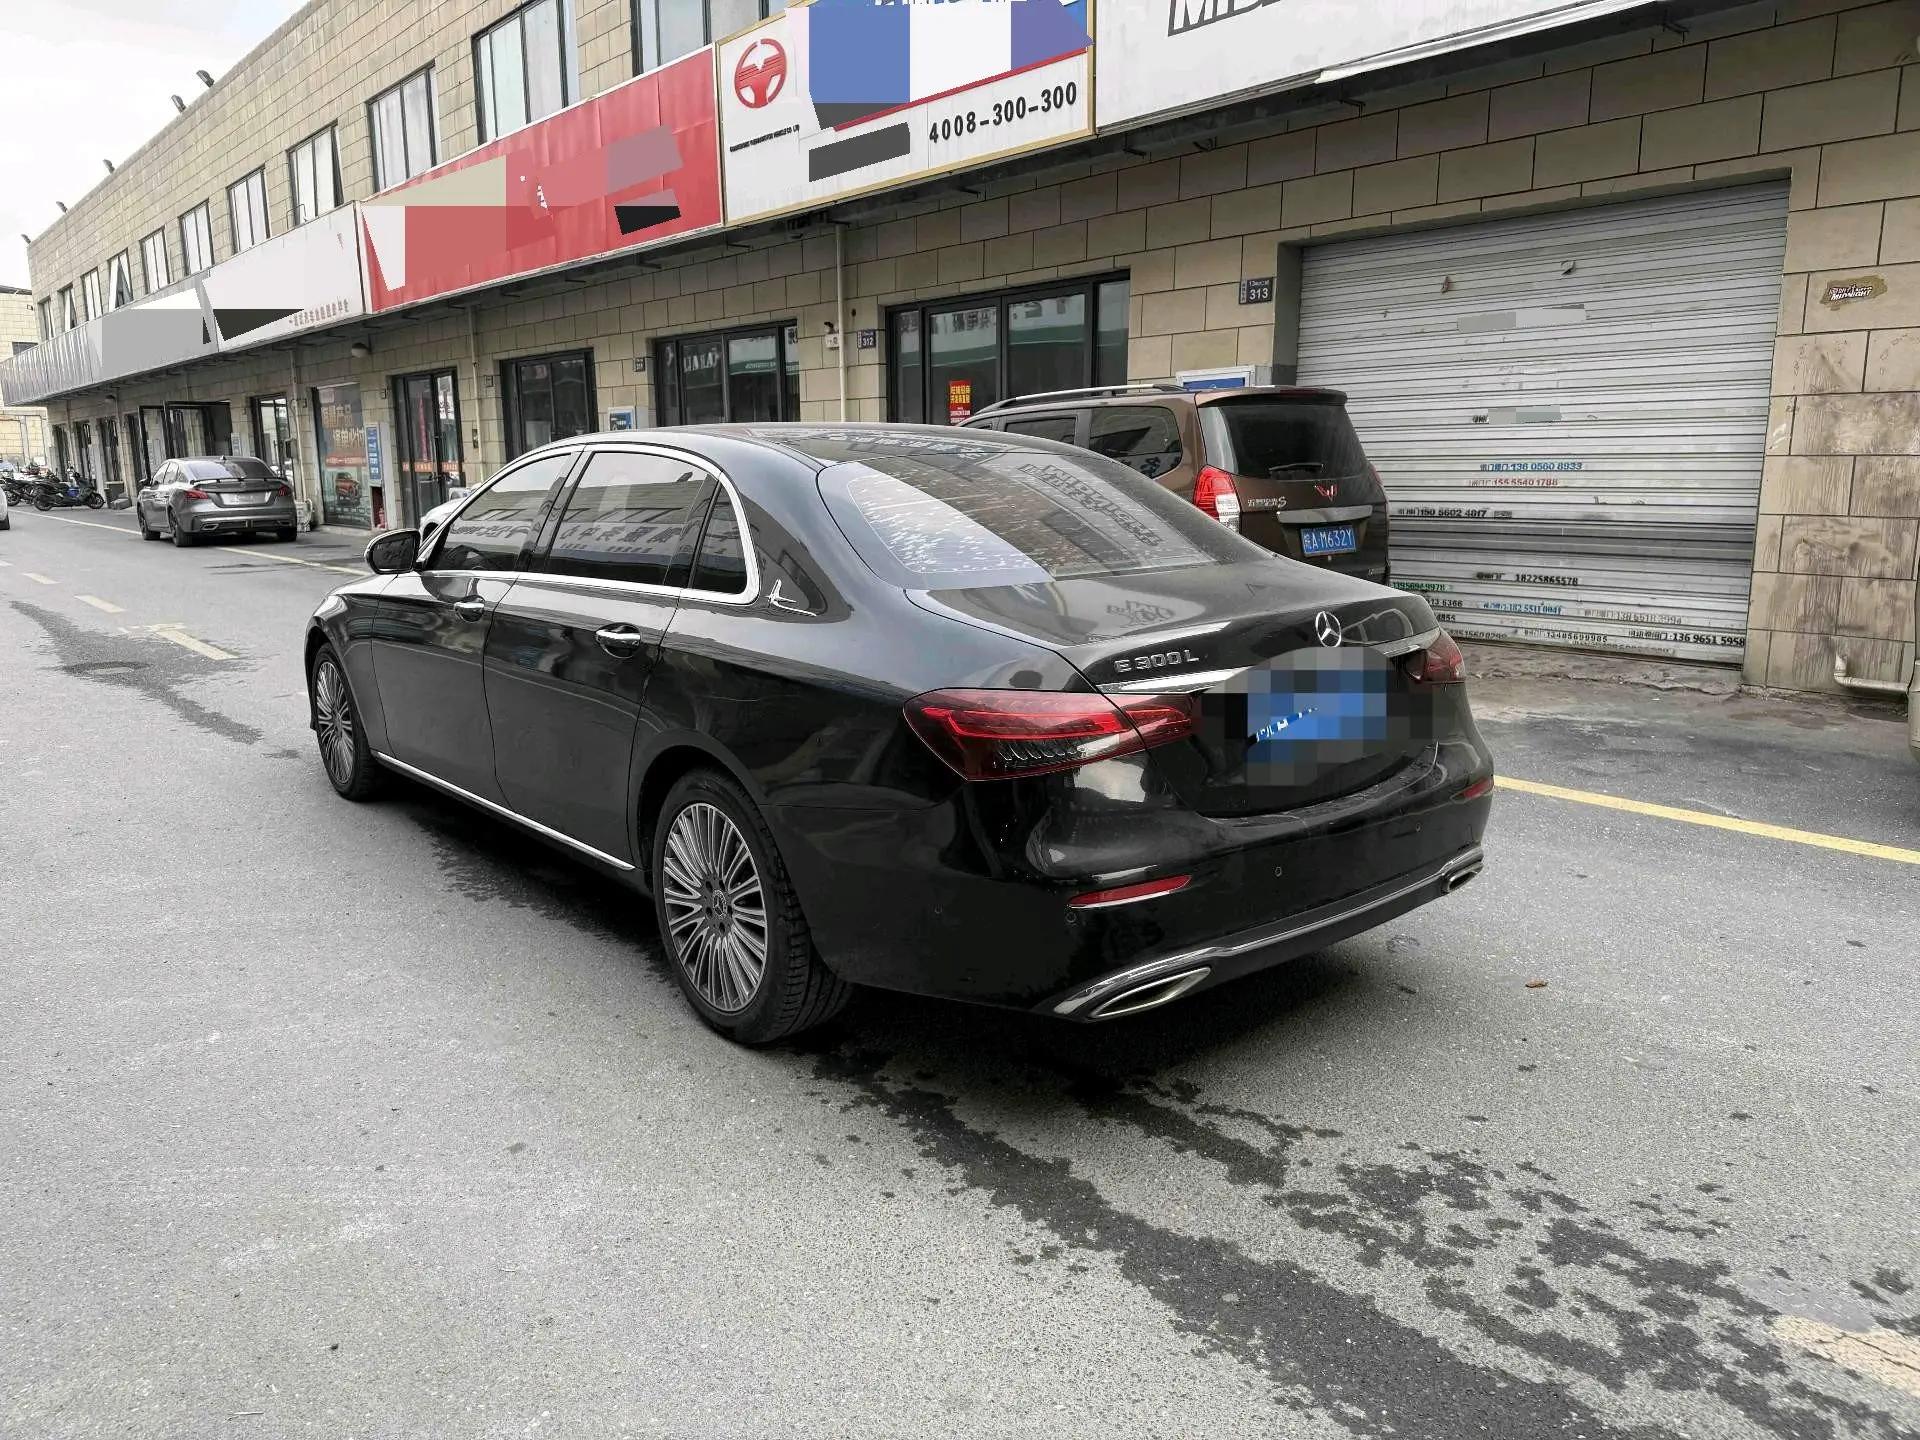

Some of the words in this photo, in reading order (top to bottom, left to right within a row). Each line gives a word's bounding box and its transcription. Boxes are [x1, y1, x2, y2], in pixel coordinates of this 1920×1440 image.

[929, 81, 1077, 144] 4008-300-300
[1250, 287, 1269, 300] 313
[1673, 632, 1691, 642] 136
[1693, 634, 1717, 644] 9651
